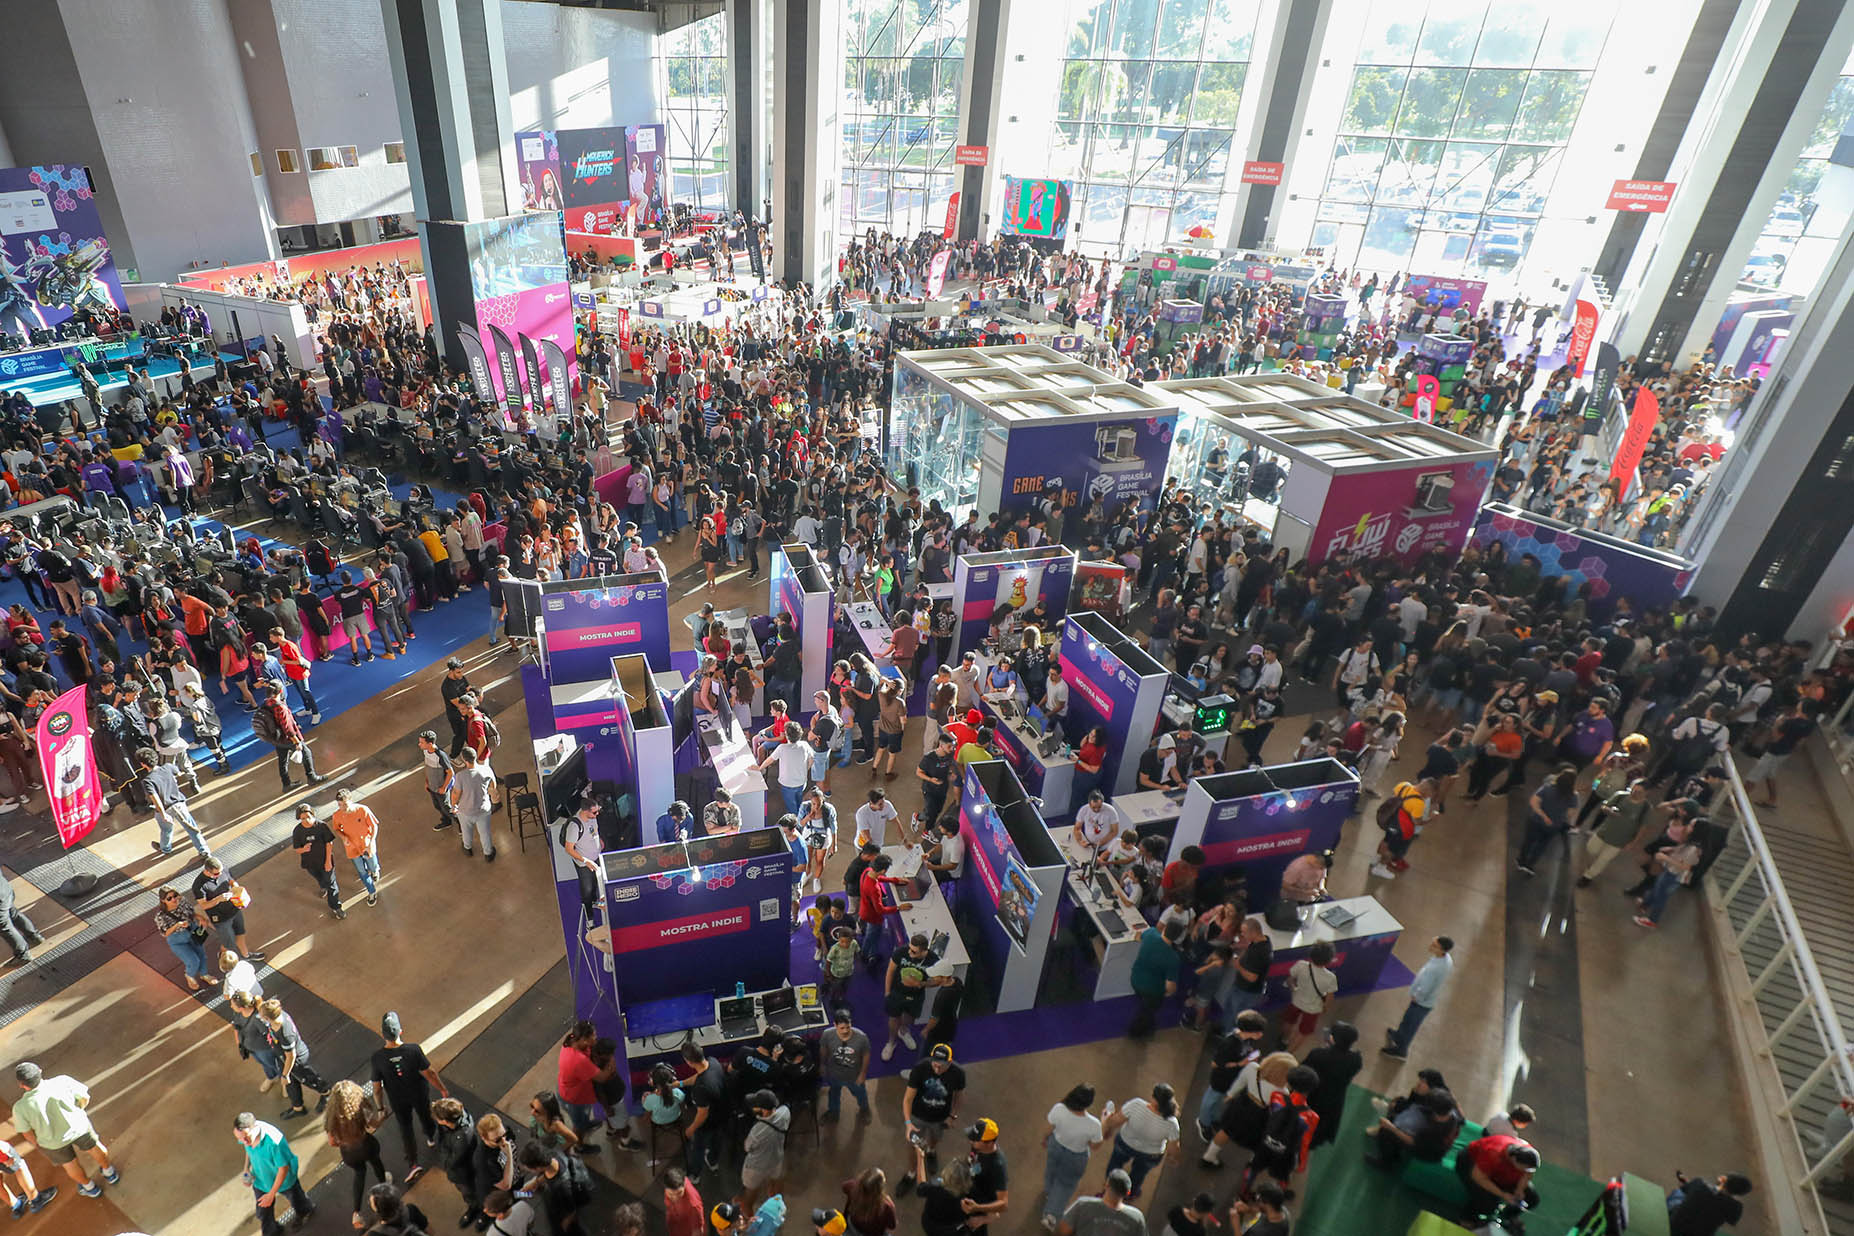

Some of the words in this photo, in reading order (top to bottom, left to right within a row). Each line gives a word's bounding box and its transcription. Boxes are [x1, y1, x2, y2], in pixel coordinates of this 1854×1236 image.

[586, 150, 614, 162] MAVERICK
[575, 157, 614, 178] HUNTERS
[1613, 192, 1668, 201] EMERGÊNCIA
[1120, 471, 1152, 481] BRASÍLIA
[1013, 475, 1044, 494] GAME
[1118, 482, 1140, 490] GAME
[599, 561, 606, 577] 9
[580, 632, 613, 641] MOSTRA
[1076, 676, 1096, 699] MOSTRA
[61, 808, 91, 824] VIVA
[1237, 842, 1275, 854] MOSTRA
[1277, 837, 1303, 848] INDIE
[660, 923, 709, 937] MOSTRA
[712, 916, 743, 928] INDIE
